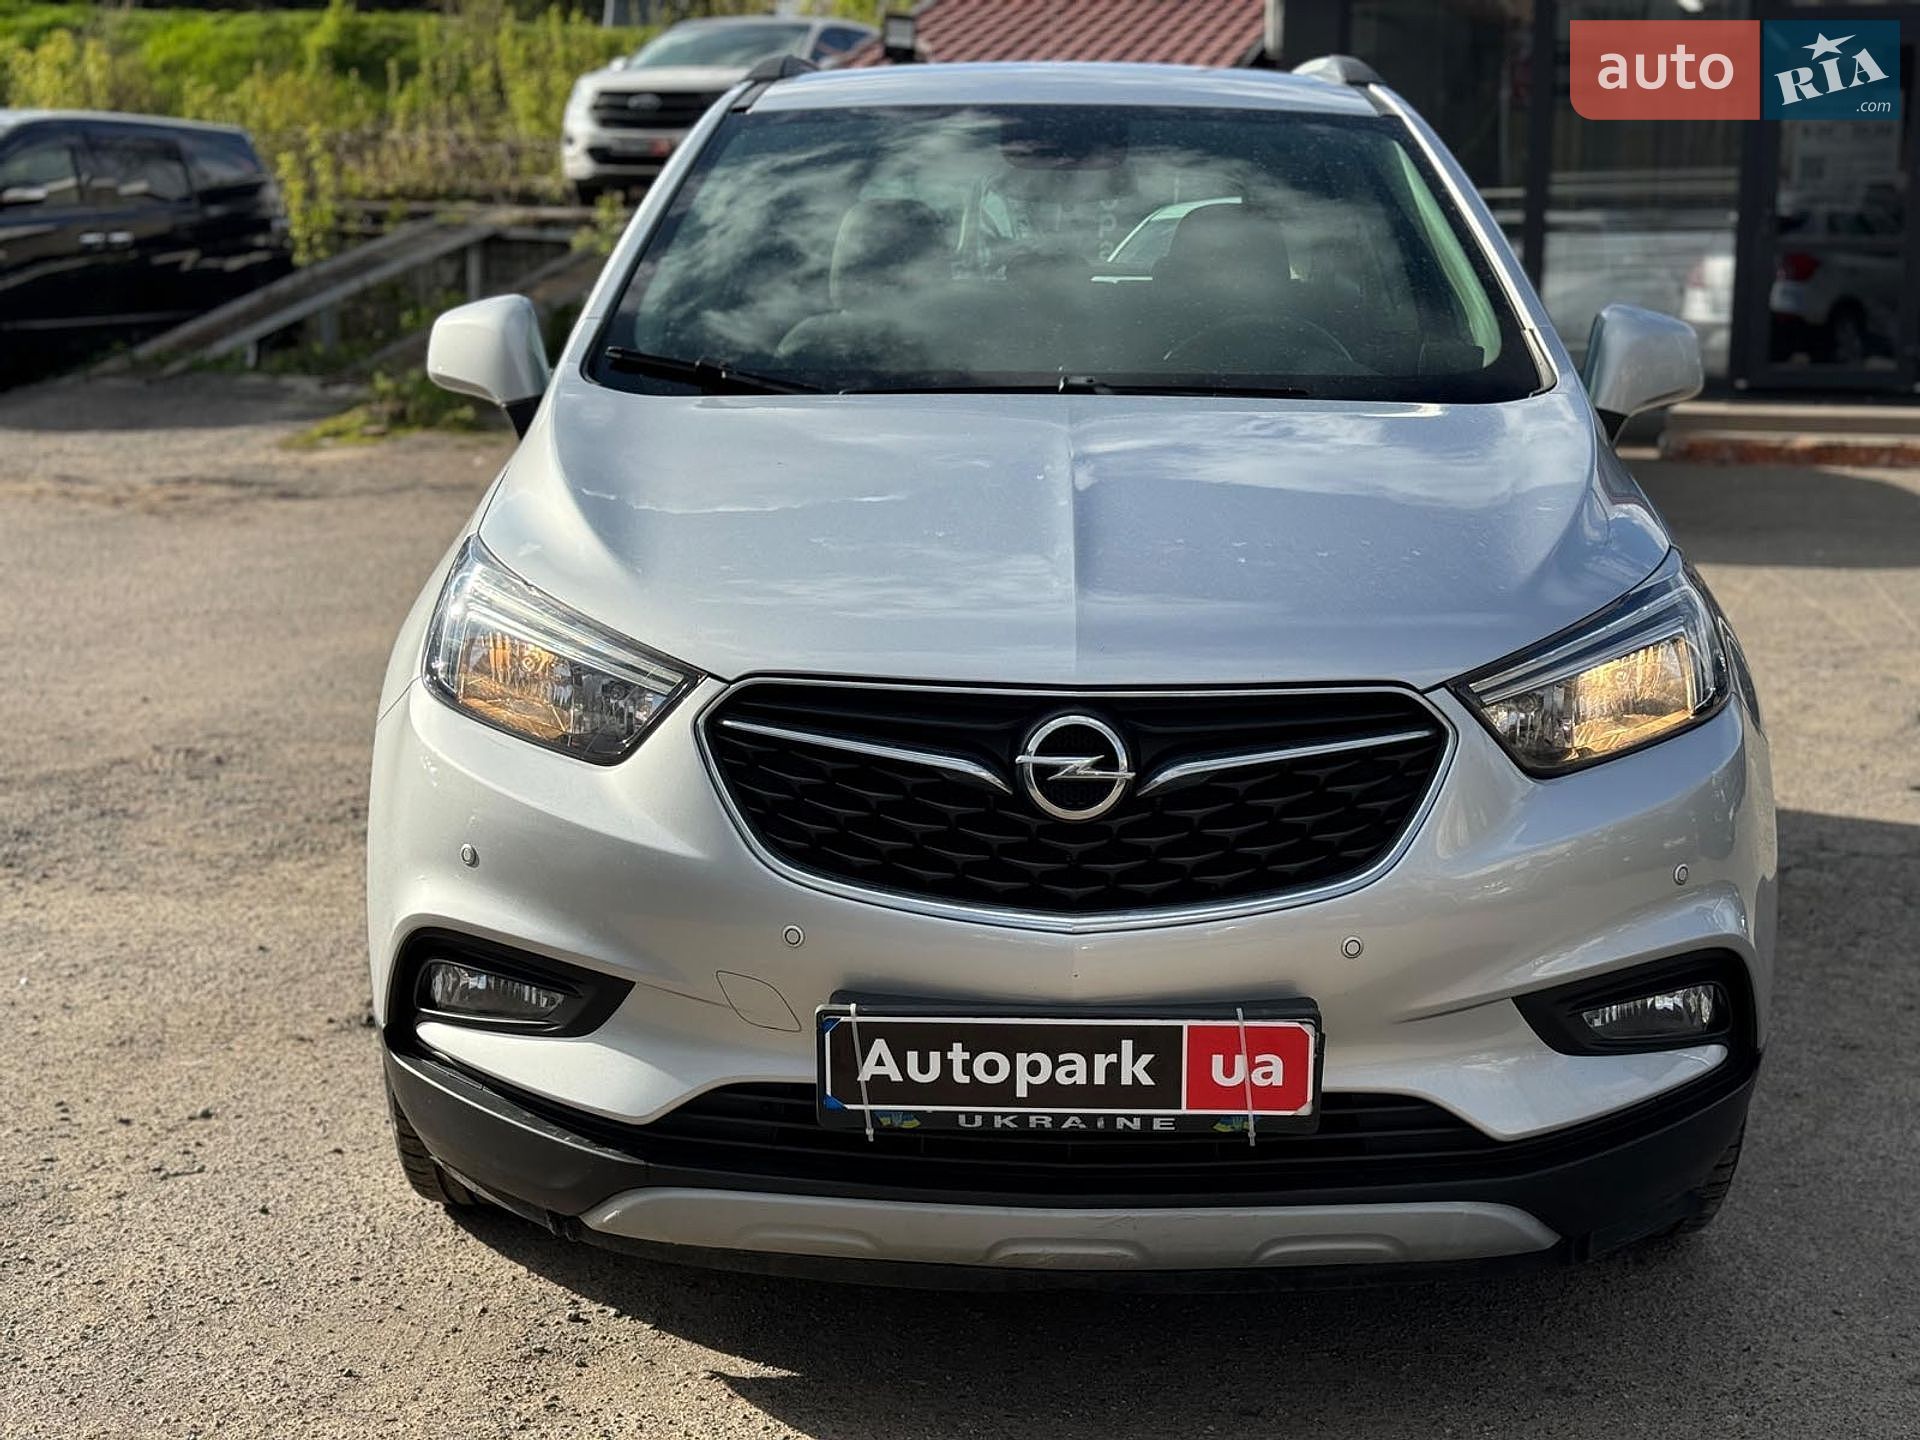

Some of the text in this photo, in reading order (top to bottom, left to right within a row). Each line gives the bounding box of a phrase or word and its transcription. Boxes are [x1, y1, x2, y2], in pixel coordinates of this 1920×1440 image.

[856, 1038, 1284, 1098] Autopark ua
[958, 1113, 1176, 1131] UKRAINE
